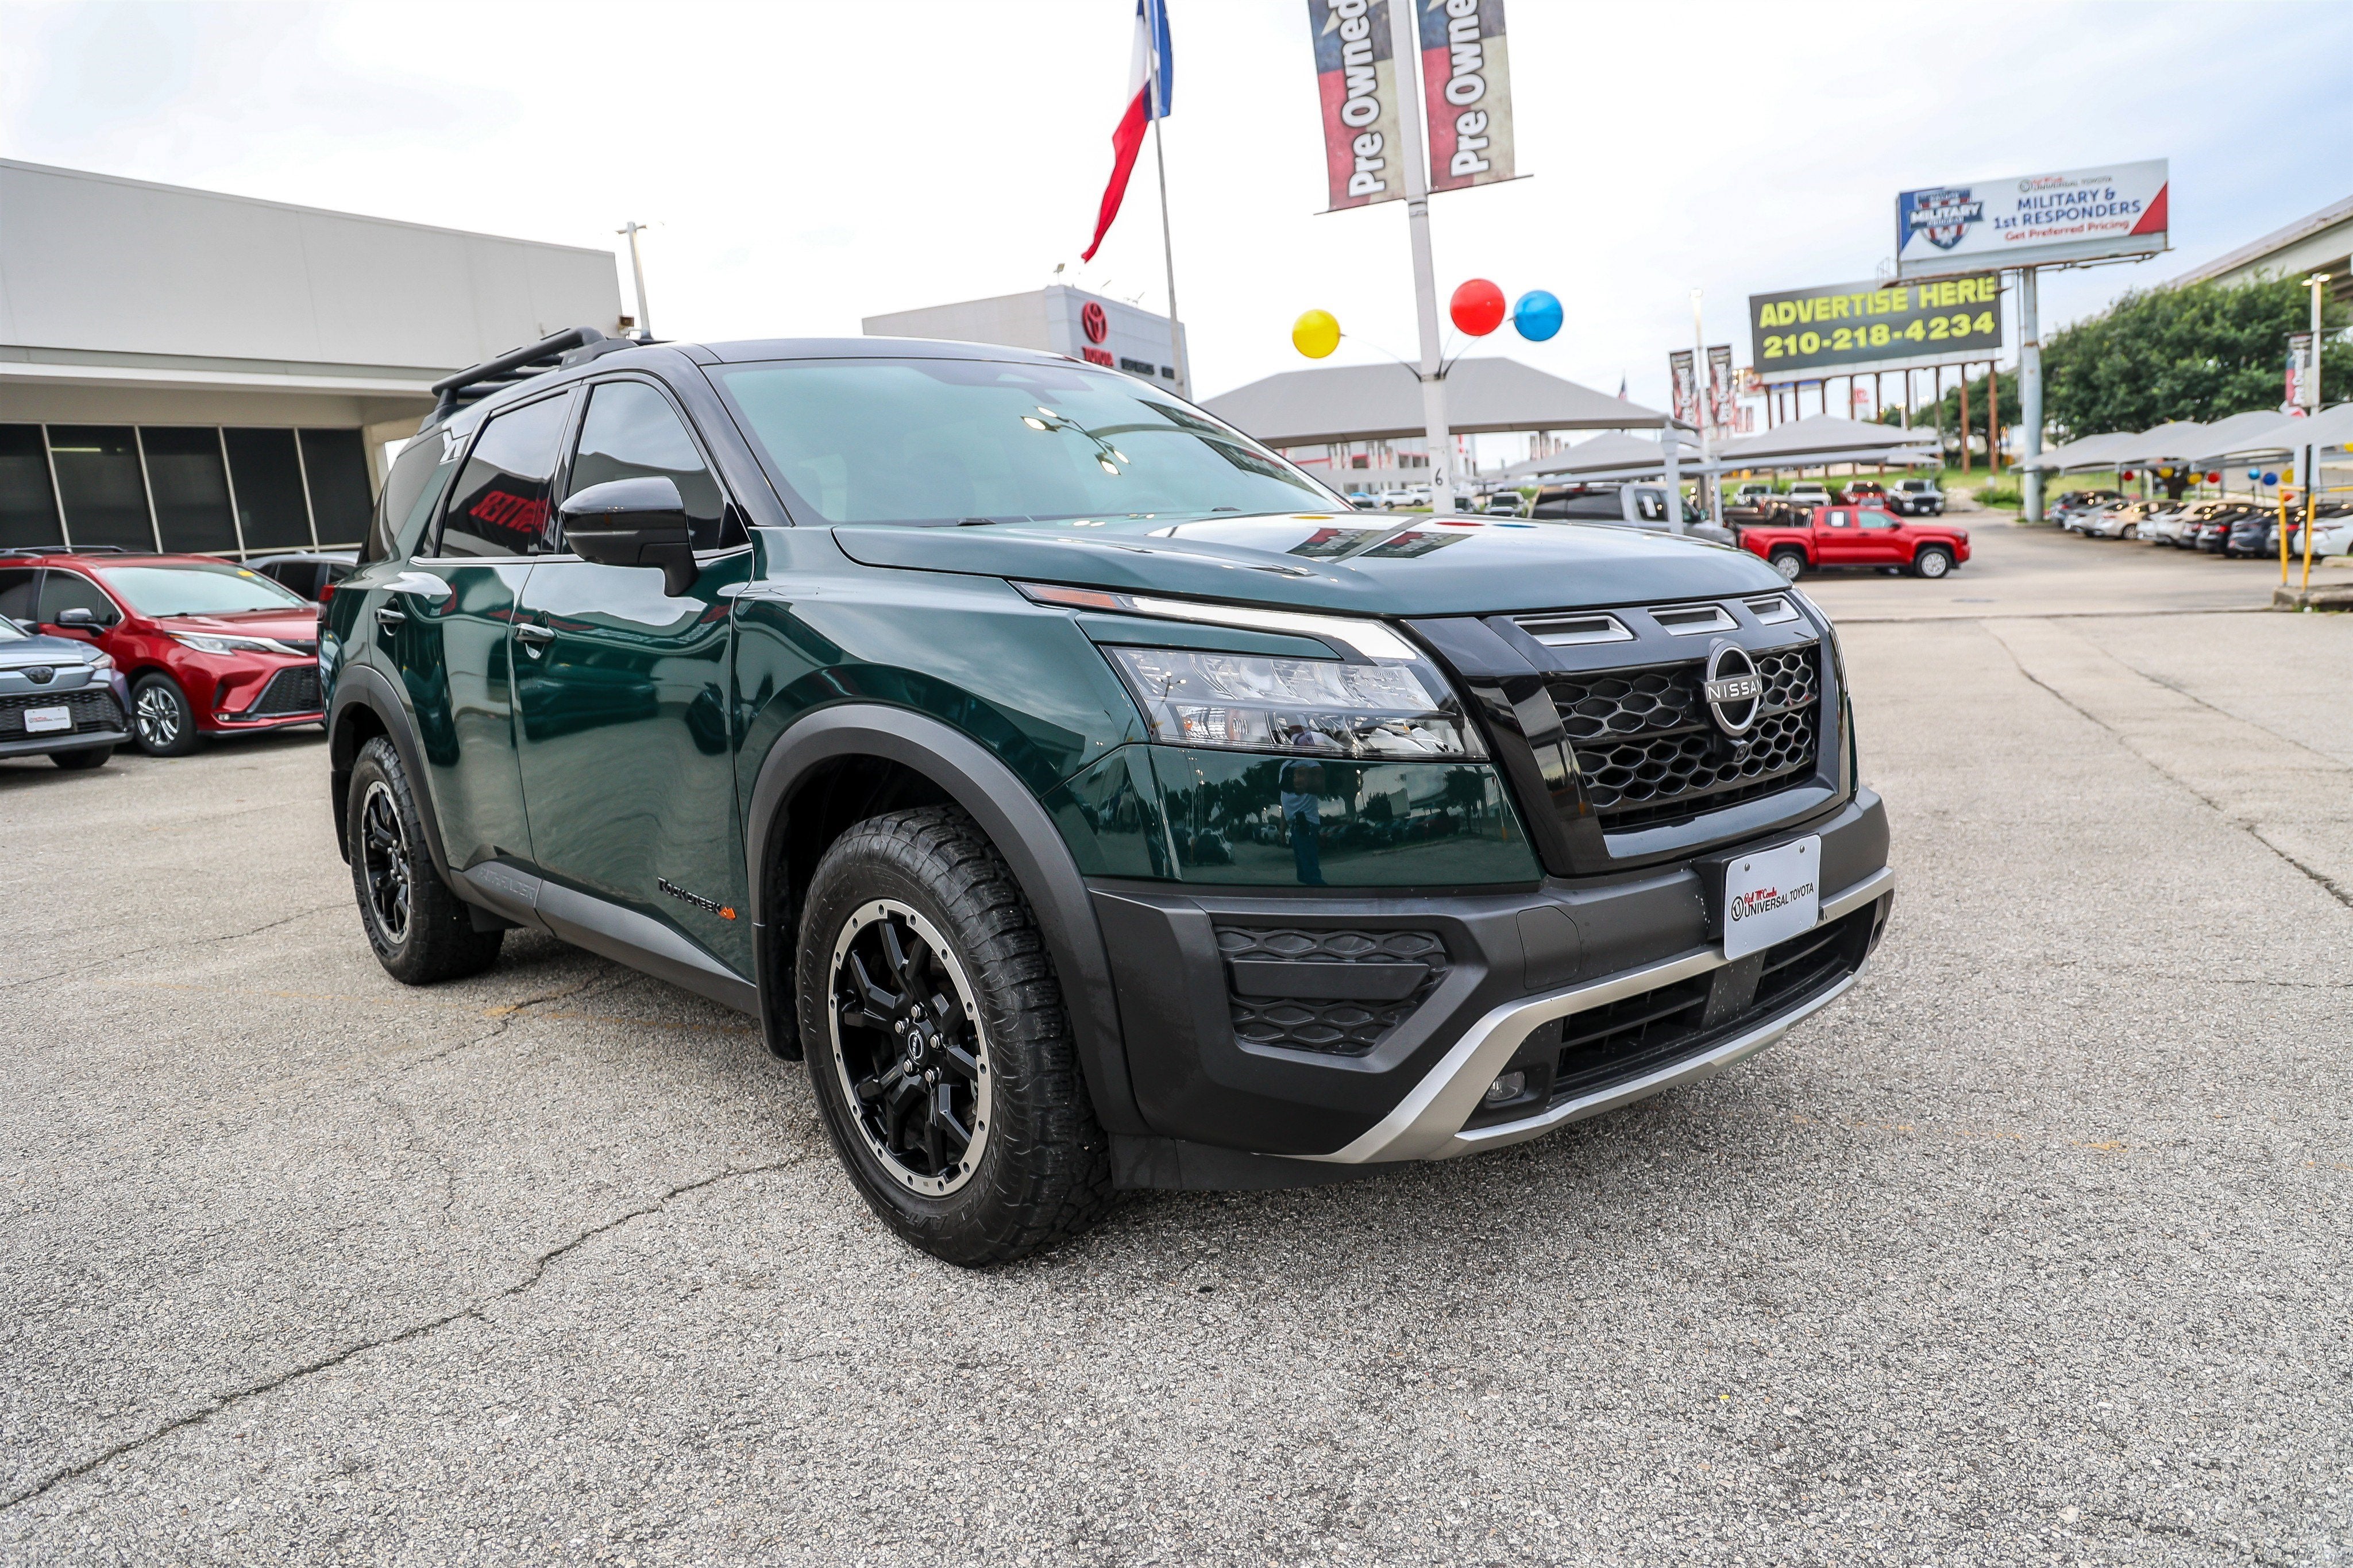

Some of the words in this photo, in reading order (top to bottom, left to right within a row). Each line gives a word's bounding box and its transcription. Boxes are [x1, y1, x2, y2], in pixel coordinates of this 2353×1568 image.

[1328, 0, 1381, 128] Owned
[1450, 110, 1489, 177] Pre
[1348, 132, 1386, 198] Pre
[1910, 202, 1982, 224] MILITARY
[1994, 215, 2018, 229] 1st
[2023, 199, 2142, 225] RESPONDERS
[2018, 189, 2100, 211] MILITARY
[2104, 187, 2116, 200] &
[2005, 230, 2025, 241] Get
[2029, 224, 2084, 237] Preferred
[2088, 219, 2130, 231] Pricing
[1758, 287, 1909, 329] ADVERTISE
[1918, 276, 1996, 310] HERE
[1762, 311, 1996, 360] 210-218-4234
[1435, 467, 1443, 486] 6
[1707, 678, 1763, 700] NISSAN
[658, 876, 686, 902] ROCK
[686, 891, 723, 915] CREEK
[1744, 892, 1755, 906] Red
[1744, 894, 1789, 918] UNIVERSAL
[1789, 882, 1814, 902] TOYOTA
